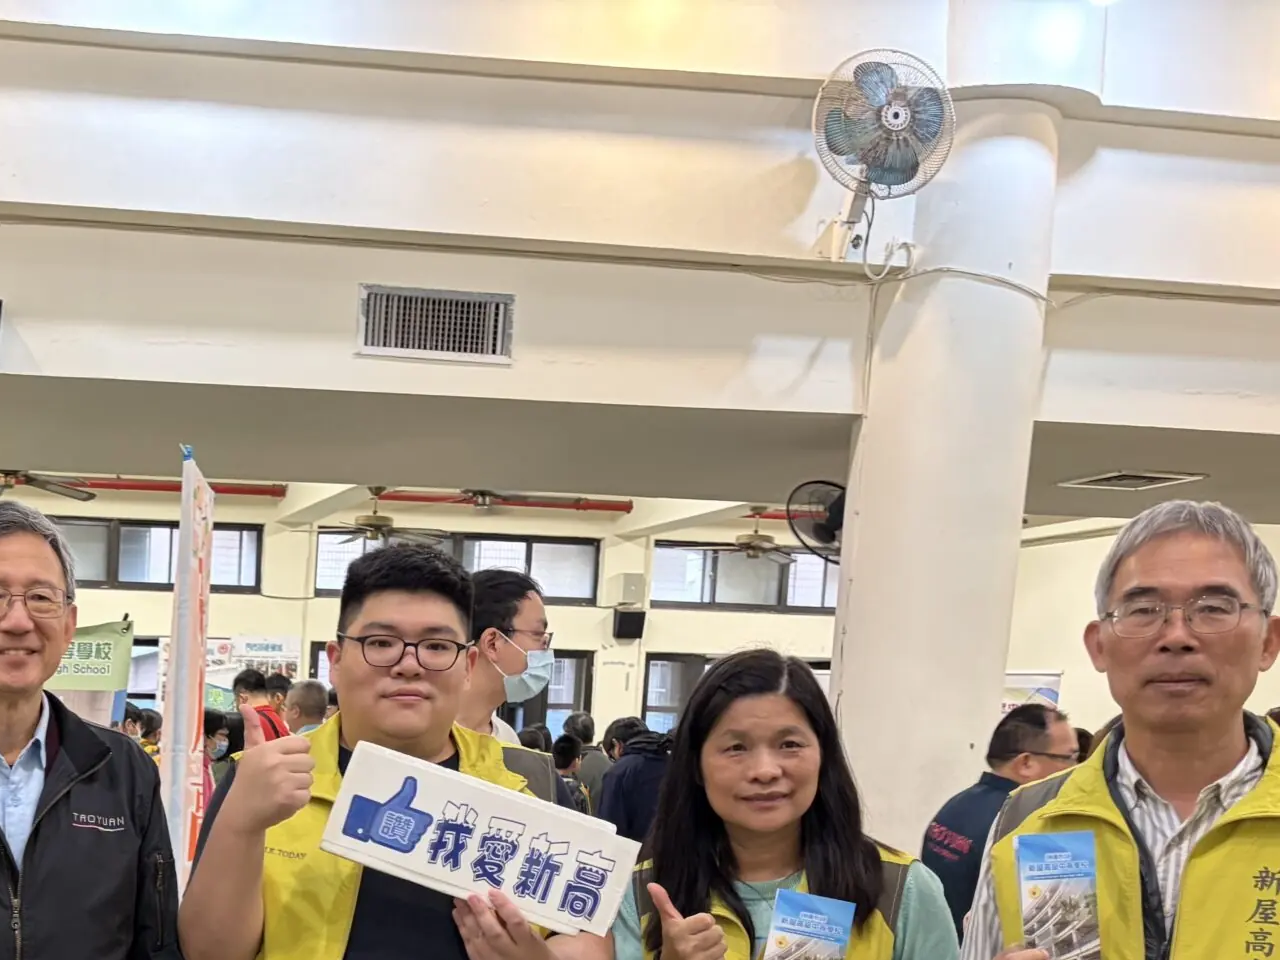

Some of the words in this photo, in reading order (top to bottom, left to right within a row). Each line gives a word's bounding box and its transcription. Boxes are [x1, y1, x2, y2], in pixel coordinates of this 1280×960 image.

[73, 663, 110, 674] School
[72, 812, 125, 827] TAOYUAN
[426, 799, 617, 923] 我愛新高
